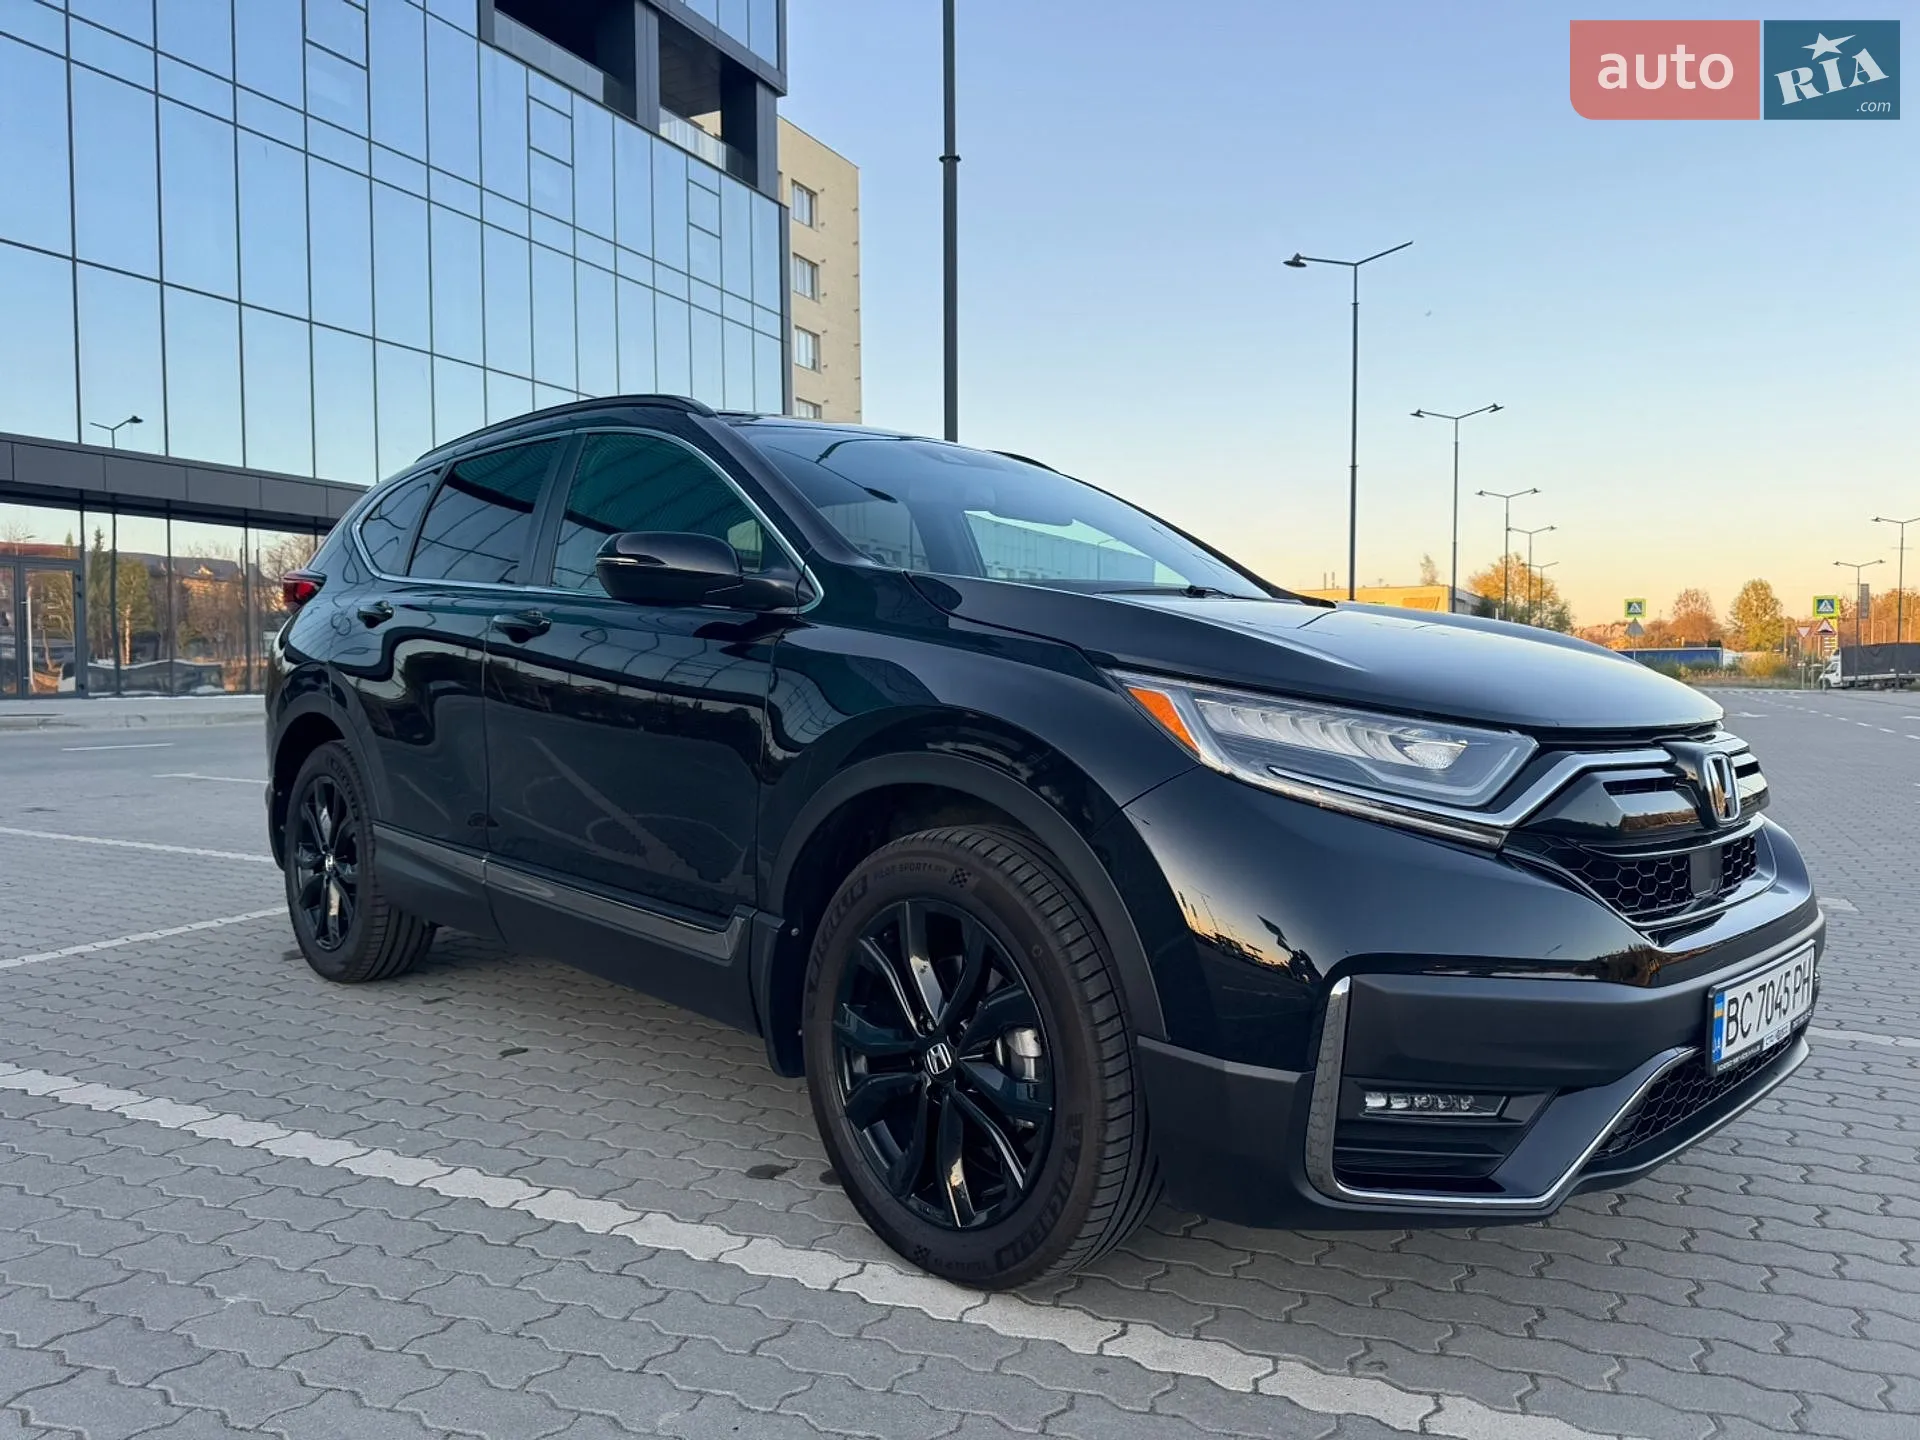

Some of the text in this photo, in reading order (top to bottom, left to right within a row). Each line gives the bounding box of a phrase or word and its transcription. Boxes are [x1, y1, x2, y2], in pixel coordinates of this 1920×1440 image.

[1726, 956, 1812, 1047] BC 7045 PH
